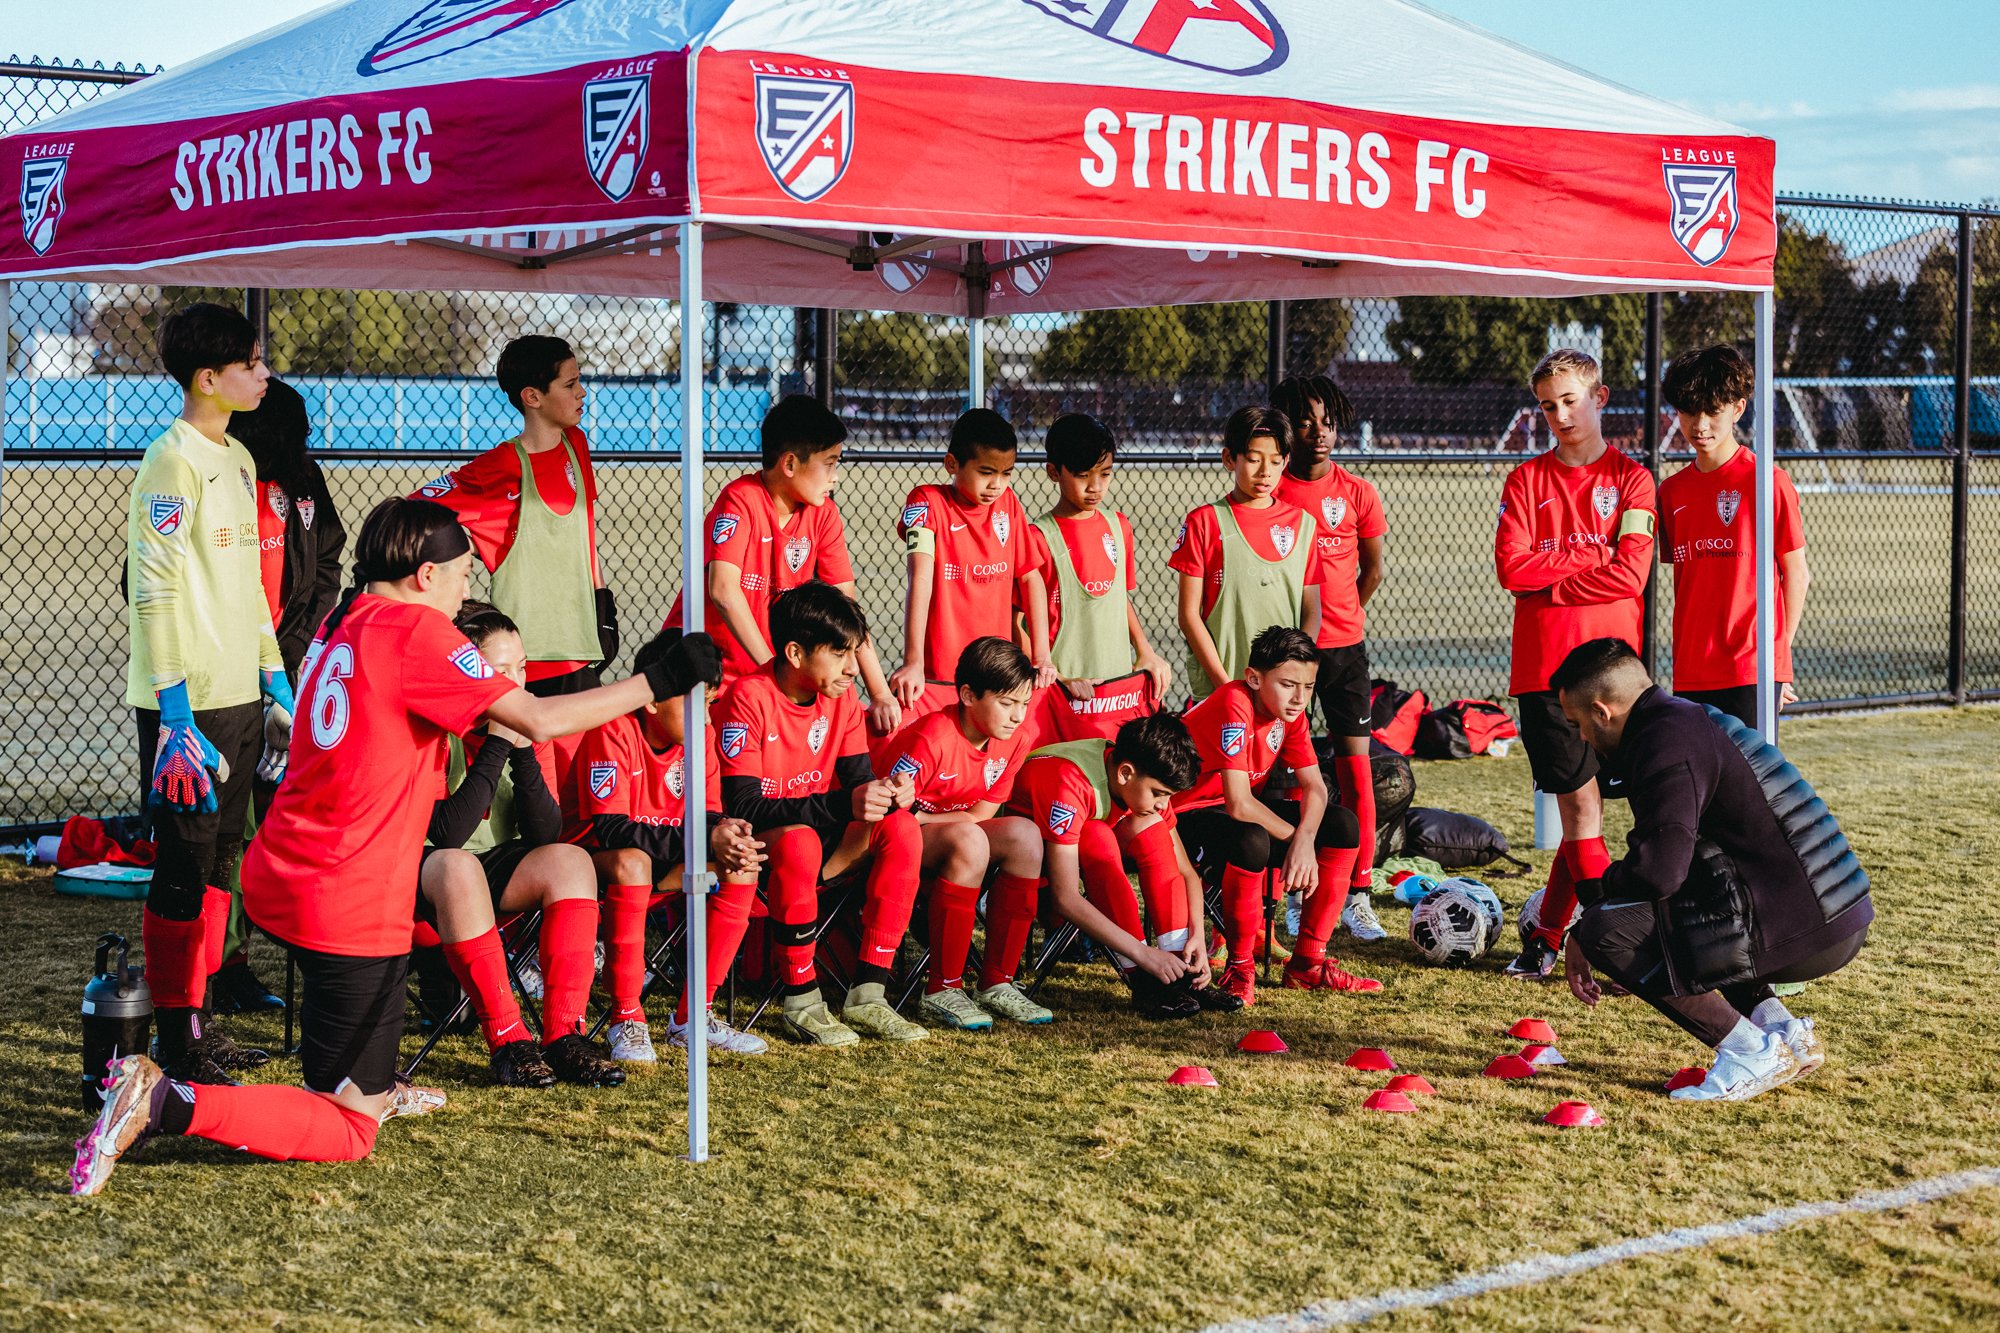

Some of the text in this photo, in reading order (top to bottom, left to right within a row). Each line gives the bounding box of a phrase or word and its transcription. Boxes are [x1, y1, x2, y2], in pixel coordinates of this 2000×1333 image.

[591, 59, 657, 80] LEAGUE
[749, 59, 850, 79] LEAGUE
[24, 143, 75, 158] LEAGUE
[170, 107, 432, 211] STRIKERS FC
[1661, 147, 1736, 164] LEAGUE
[1080, 107, 1489, 219] STRIKERS FC
[907, 530, 919, 550] C
[1317, 536, 1341, 548] SCO
[1695, 538, 1733, 550] COSCO
[973, 561, 1008, 576] COSCO
